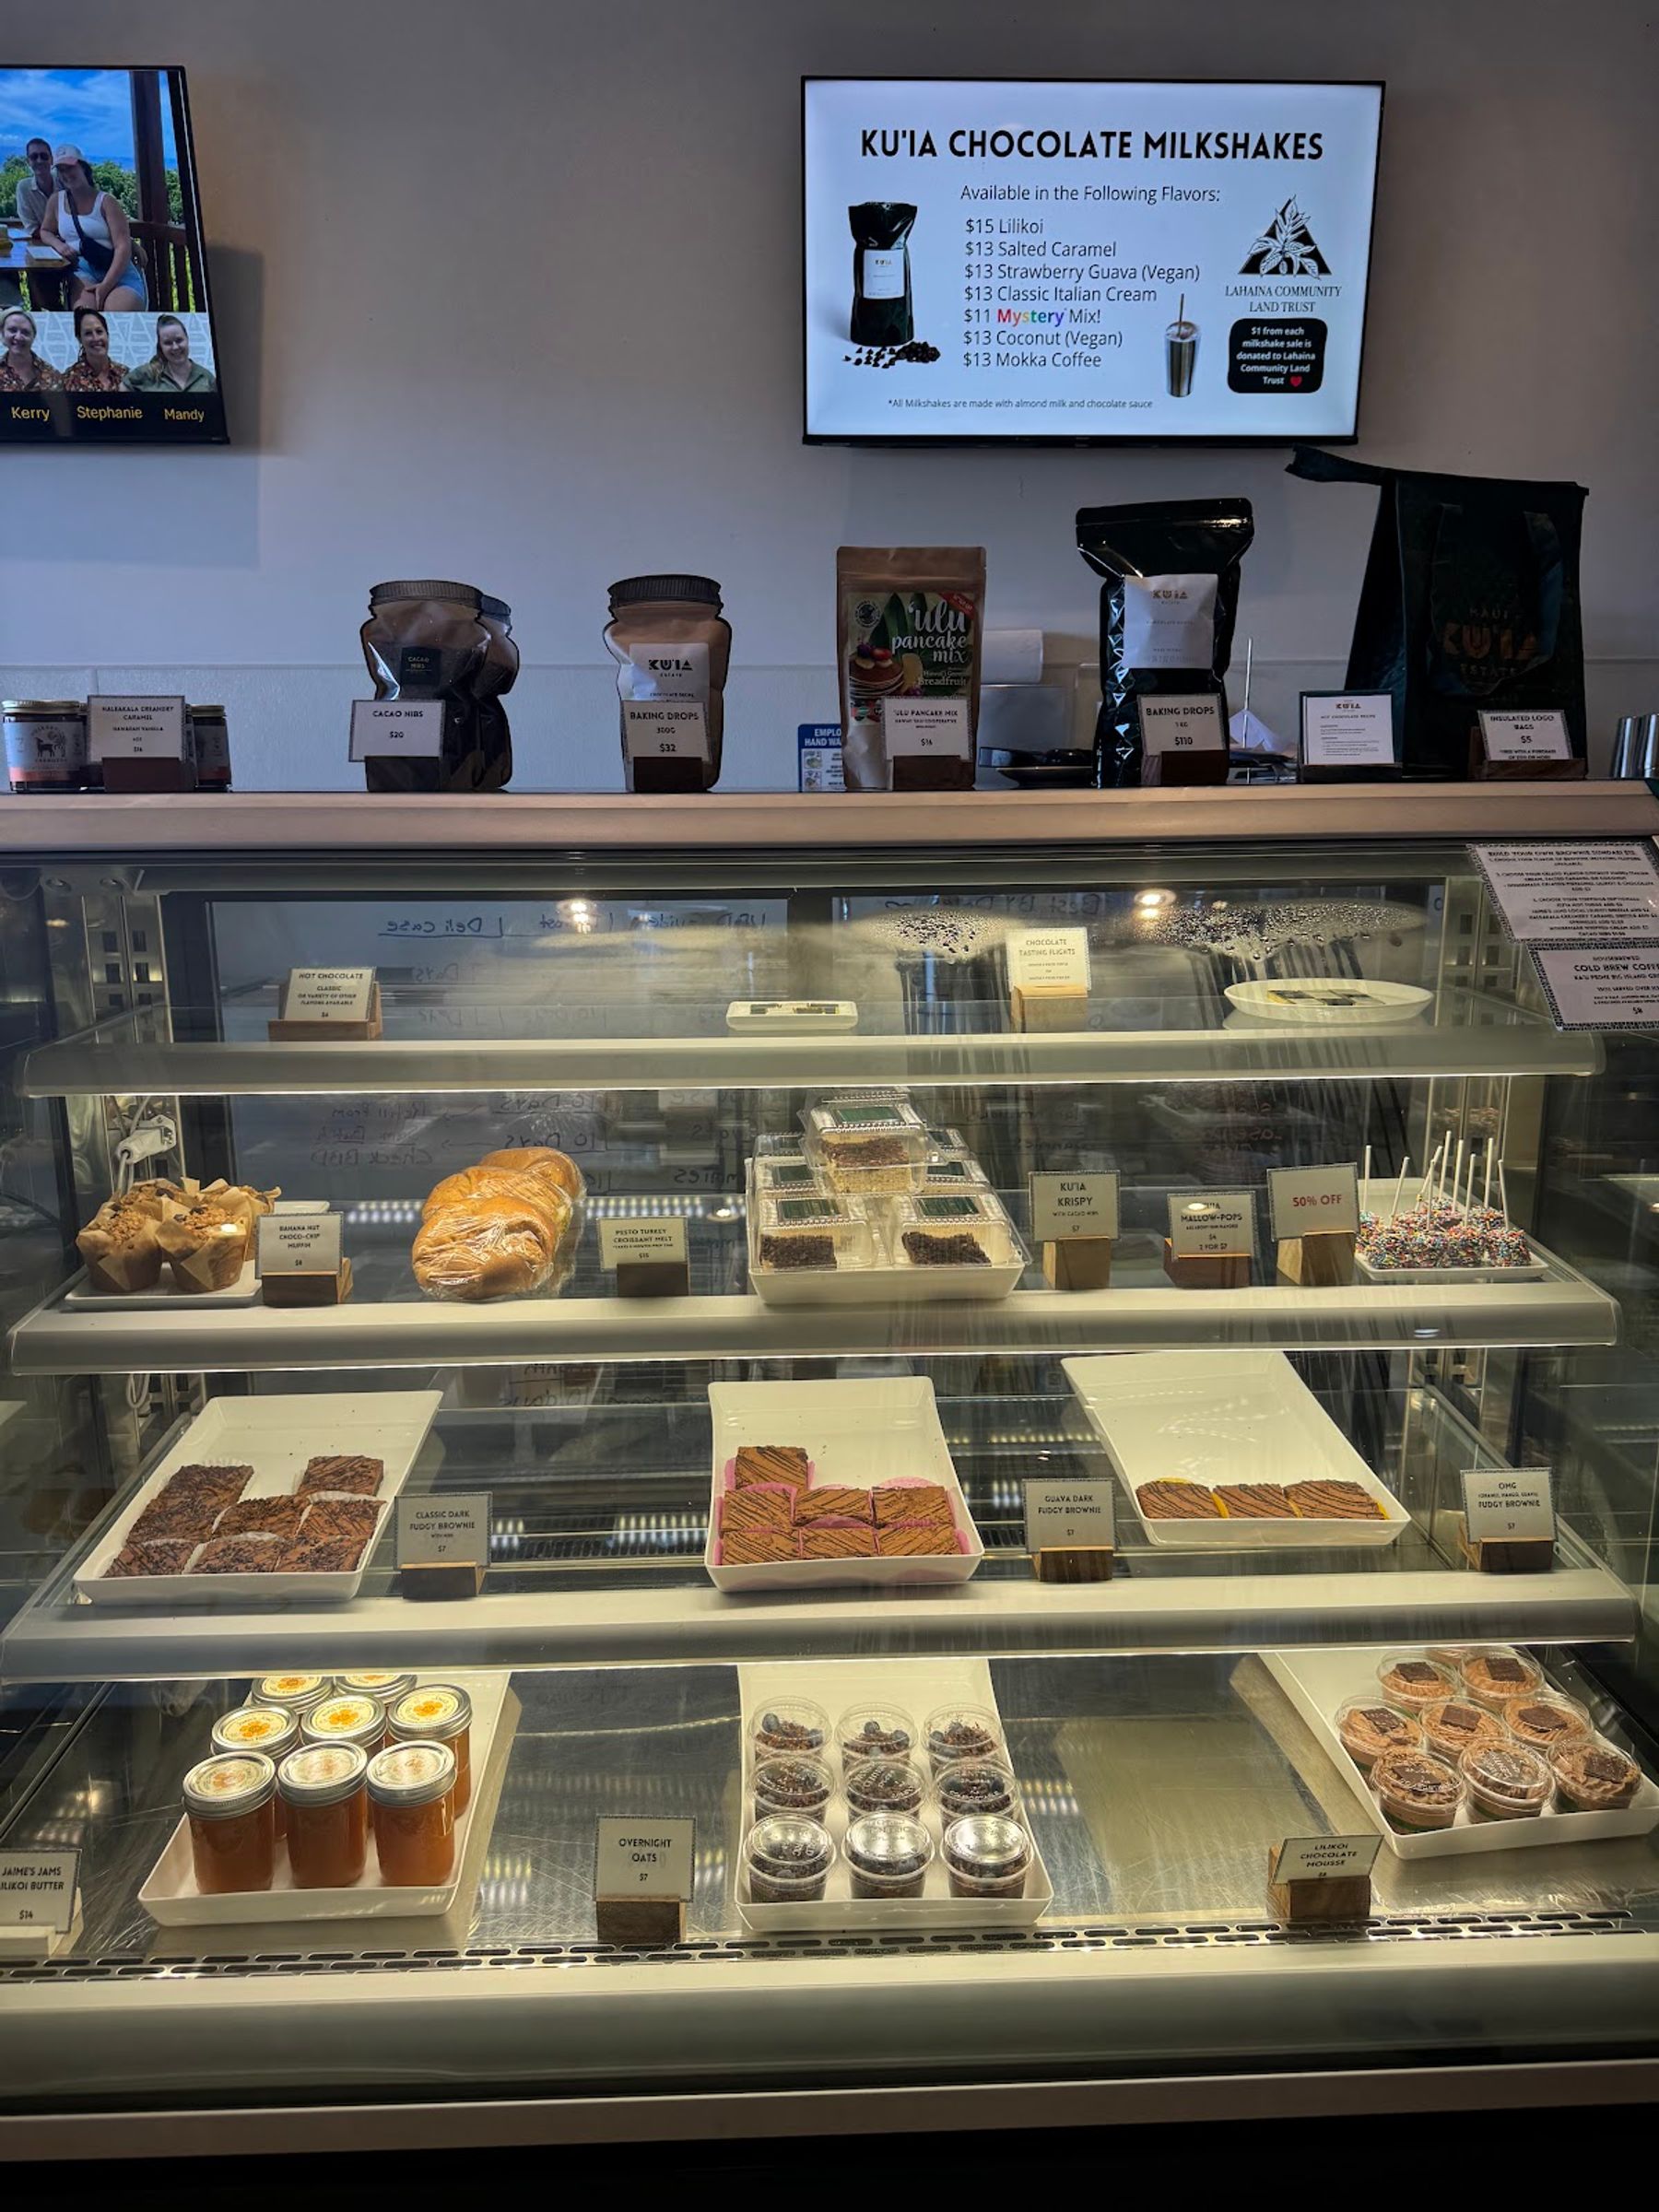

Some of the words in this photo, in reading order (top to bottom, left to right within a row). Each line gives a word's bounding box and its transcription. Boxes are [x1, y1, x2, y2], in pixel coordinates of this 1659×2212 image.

[862, 130, 937, 157] KU'IA
[948, 130, 1132, 158] CHOCOLATE
[1144, 131, 1324, 159] MILKSHAKES
[960, 185, 1030, 200] Available
[1035, 185, 1050, 200] in
[1053, 186, 1079, 201] the
[1084, 185, 1157, 206] Following
[1162, 186, 1220, 202] Flavors:
[966, 218, 994, 234] $15
[999, 218, 1044, 234] Lilikoi
[965, 241, 994, 257] $13
[998, 241, 1047, 257] Salted
[1052, 241, 1117, 257] Caramel
[965, 264, 994, 279] $13
[997, 264, 1084, 283] Strawberry
[1088, 264, 1137, 279] Guava
[1141, 265, 1200, 284] (Vegan)
[964, 286, 993, 301] $13
[997, 286, 1050, 301] Classic
[1054, 286, 1101, 301] Italian
[1106, 287, 1157, 301] Cream
[1225, 286, 1272, 297] LAHAINA
[1274, 286, 1342, 297] COMMUNITY
[1249, 301, 1278, 312] LAND
[1282, 301, 1316, 312] TRUST
[964, 309, 991, 324] $11
[996, 308, 1065, 327] Mystery
[1069, 309, 1100, 324] Mix!
[1251, 326, 1262, 335] $1
[1263, 326, 1283, 335] from
[1284, 326, 1305, 335] each
[963, 330, 992, 346] $13
[996, 330, 1061, 346] Coconut
[1065, 331, 1123, 349] (Vegan)
[1241, 339, 1285, 348] milkshake
[1286, 339, 1303, 348] sale
[1304, 339, 1312, 348] is
[963, 352, 992, 368] $13
[995, 352, 1047, 367] Mokka
[1052, 352, 1101, 368] Coffee
[1236, 351, 1271, 360] donated
[1272, 352, 1282, 360] to
[1282, 351, 1316, 360] Lahaina
[1241, 364, 1288, 374] Community
[1290, 364, 1311, 372] Land
[1263, 376, 1285, 384] Trust
[905, 398, 951, 408] Milkshakes
[969, 399, 994, 408] made
[995, 398, 1014, 408] with
[1015, 398, 1048, 408] almond
[1049, 398, 1067, 408] milk
[1068, 399, 1086, 408] and
[1087, 398, 1127, 408] chocolate
[11, 406, 50, 422] Kerry
[76, 406, 143, 421] Stephanie
[164, 408, 206, 423] Mandy
[891, 629, 967, 654] pancake
[933, 648, 968, 664] mix
[1146, 707, 1181, 716] BAKING
[1182, 706, 1215, 716] DROPS
[629, 712, 665, 721] BAKING
[667, 712, 700, 721] DROPS
[804, 738, 828, 747] HAND
[1174, 736, 1194, 746] $110
[659, 743, 677, 753] $32
[1060, 1182, 1086, 1193] KU'IA
[1057, 1196, 1093, 1207] KRISPY
[1292, 1196, 1318, 1207] 50%
[1320, 1194, 1343, 1206] OFF
[1181, 1213, 1243, 1222] MALLOW-POPS
[1499, 1482, 1517, 1490] OMG
[1505, 1500, 1541, 1508] BROWNIE
[1065, 1506, 1102, 1514] BROWNIE
[409, 1523, 436, 1531] FUDGY
[438, 1522, 476, 1530] BROWNIE
[618, 1839, 672, 1848] OVERNIGHT
[631, 1853, 657, 1862] OATS
[1300, 1851, 1358, 1860] CHOCOLATE
[2, 1866, 36, 1877] JAIME'S
[38, 1866, 62, 1877] JAMS
[639, 1873, 649, 1881] $7
[30, 1881, 65, 1890] BUTTER
[19, 1910, 33, 1920] $14
